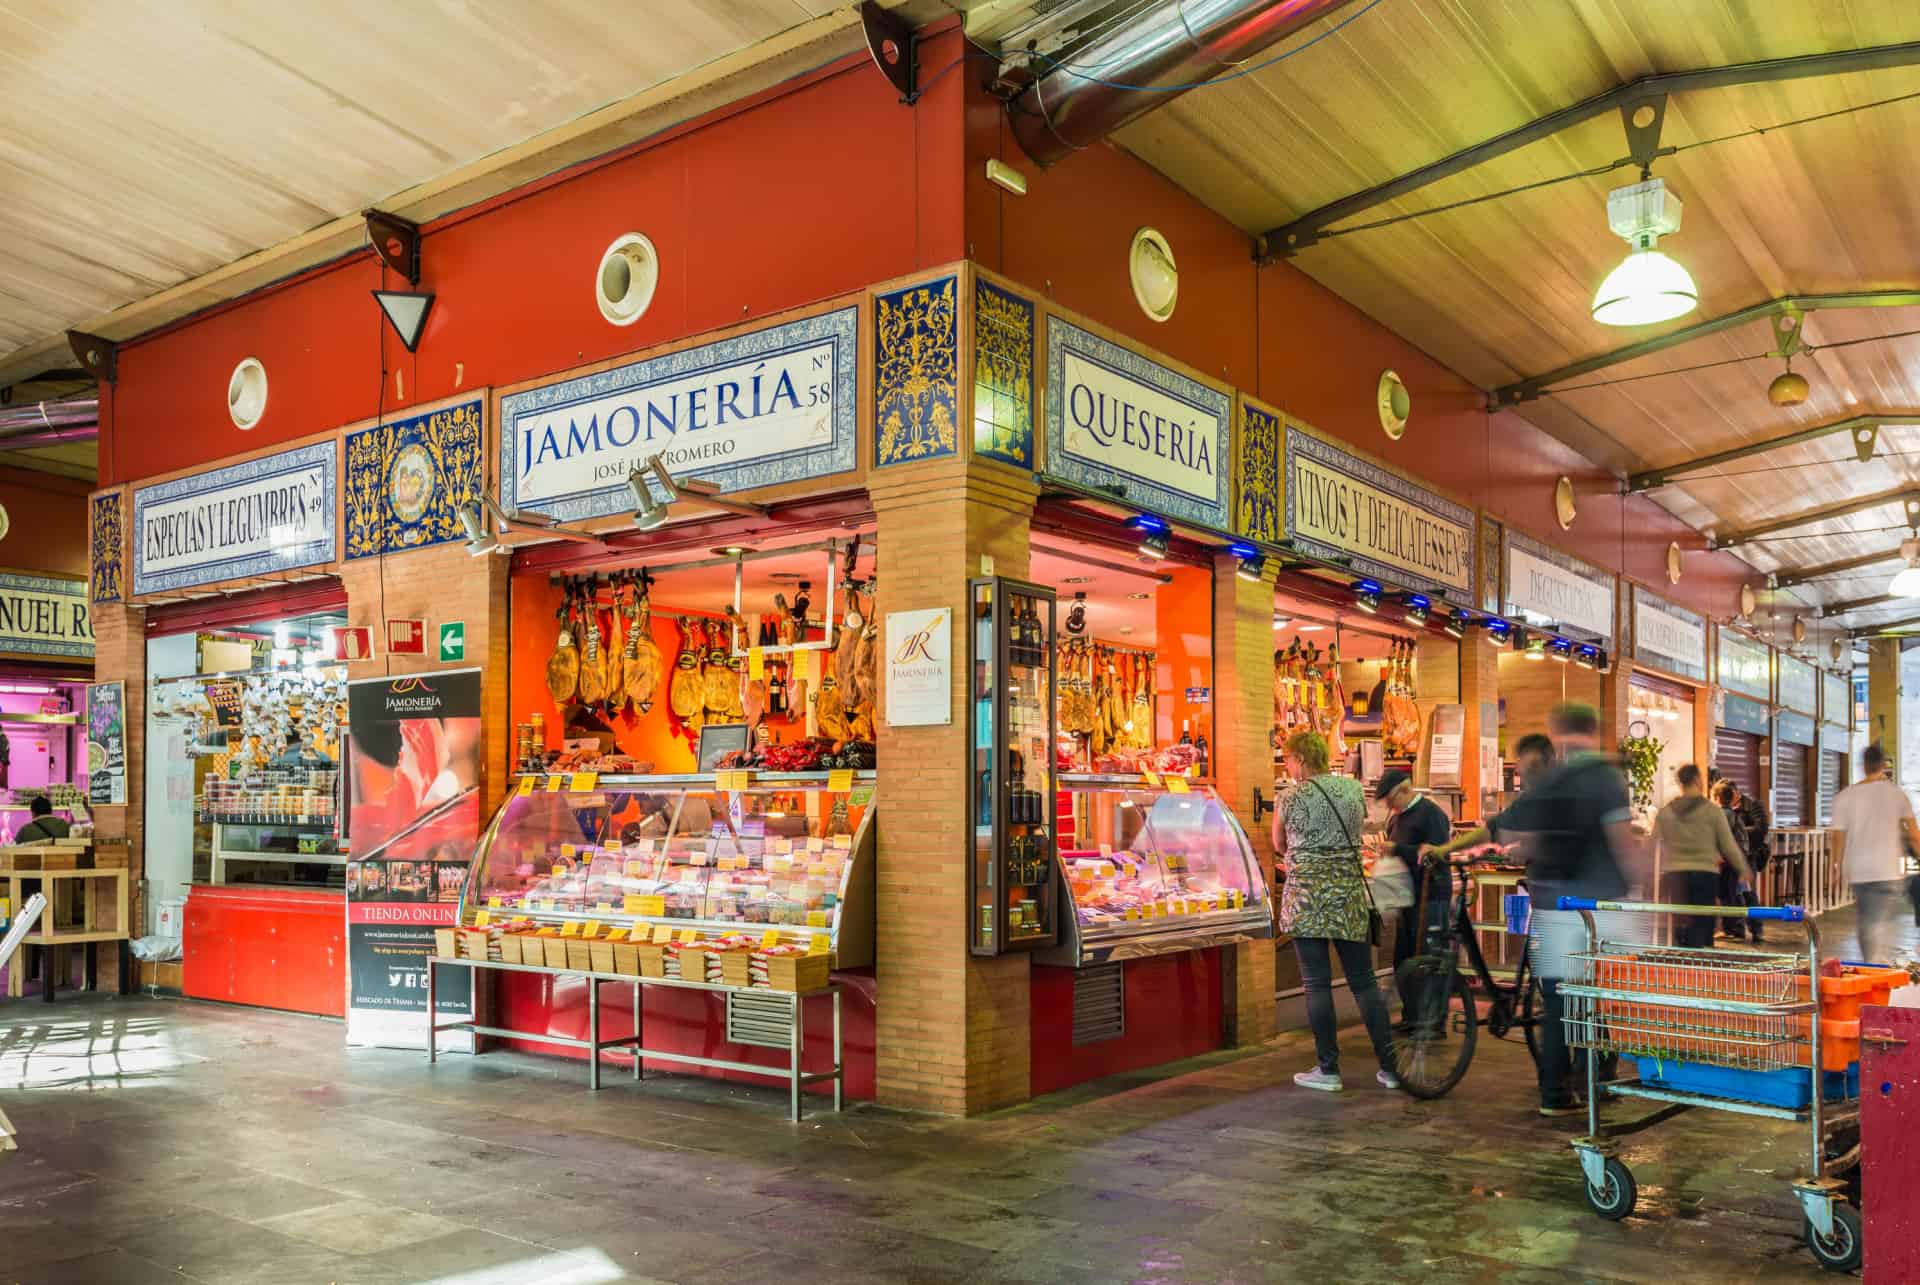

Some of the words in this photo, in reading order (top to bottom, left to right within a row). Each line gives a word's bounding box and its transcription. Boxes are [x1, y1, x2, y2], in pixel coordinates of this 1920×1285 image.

[812, 353, 830, 371] Nº
[808, 382, 830, 407] 58
[521, 362, 804, 480] JAMONERÍA
[1070, 384, 1212, 475] QUESERÍA
[593, 458, 625, 481] JOSÉ
[666, 439, 736, 465] ROMERO
[309, 496, 321, 512] 49
[146, 505, 205, 561] ESPECIAS
[206, 504, 217, 549] Y
[1297, 466, 1347, 539] VINOS
[1351, 488, 1363, 543] Y
[1368, 495, 1461, 577] DELICATESSEN
[386, 695, 441, 709] JAMONERÍA
[362, 907, 410, 920] TIENDA
[413, 908, 457, 921] ONLIN
